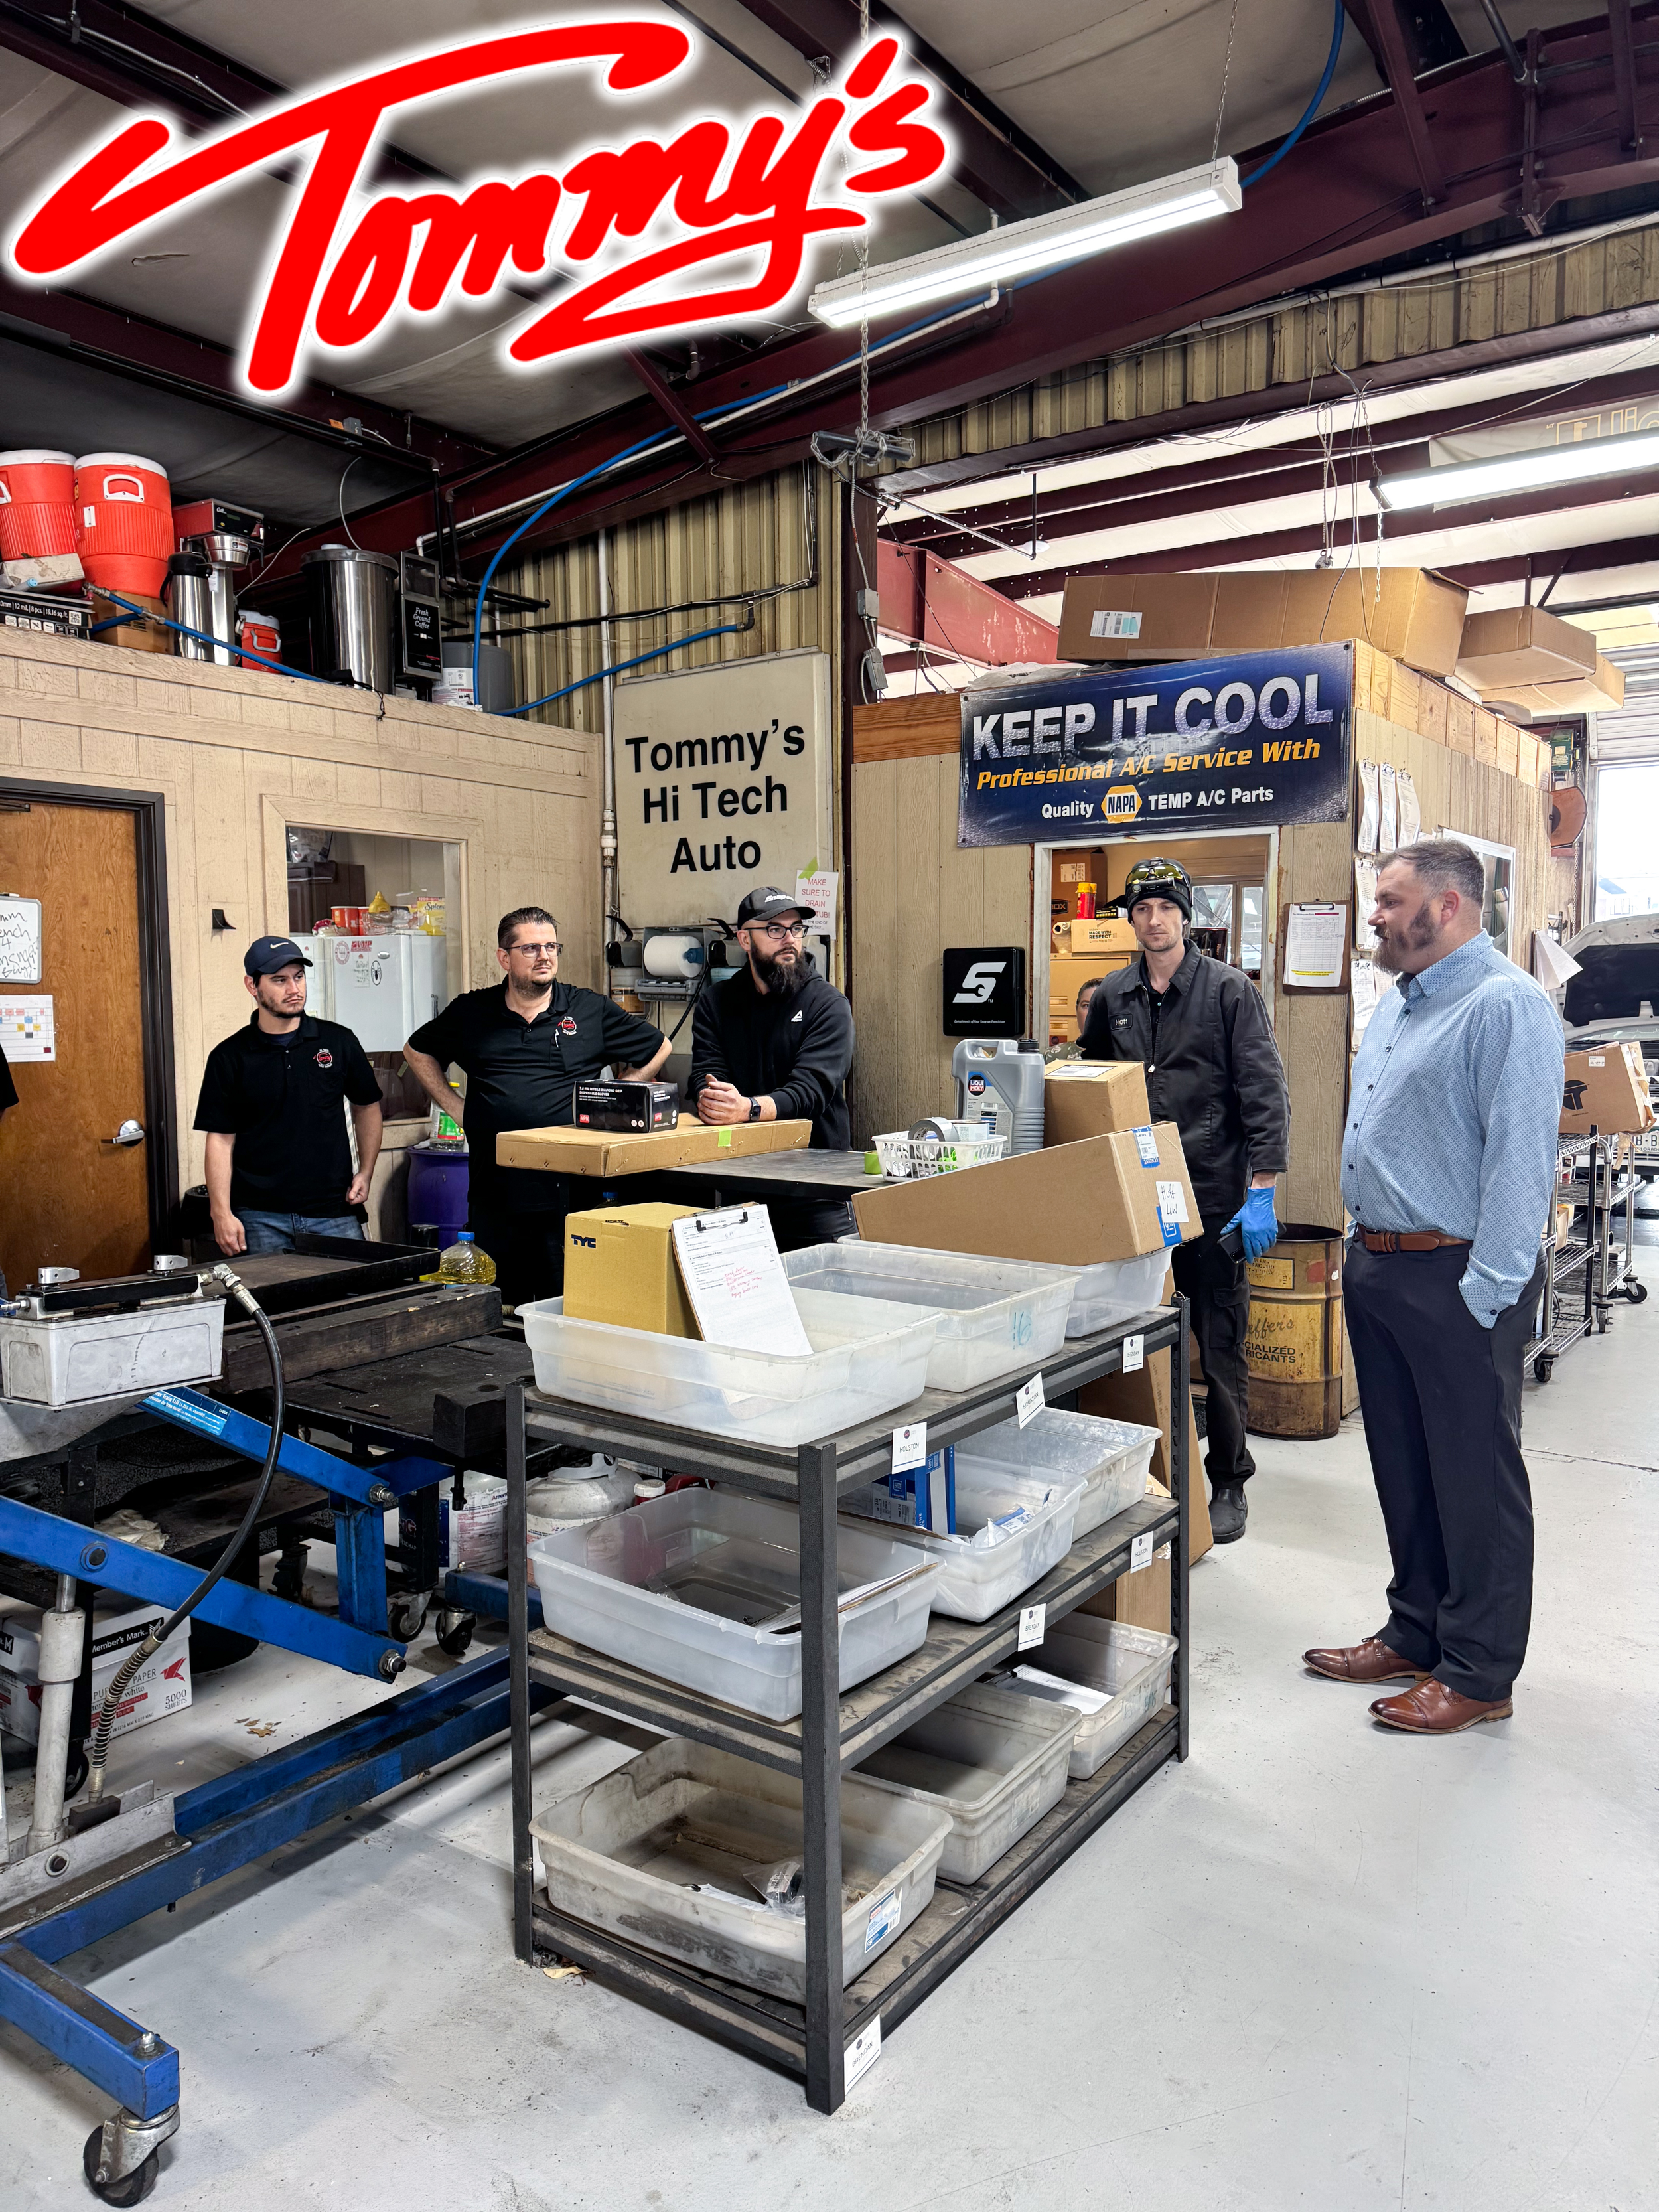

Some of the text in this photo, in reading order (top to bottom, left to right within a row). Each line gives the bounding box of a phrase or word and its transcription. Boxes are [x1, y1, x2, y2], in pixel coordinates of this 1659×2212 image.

[413, 613, 431, 623] Ground
[415, 607, 429, 617] Fresh
[415, 620, 430, 629] Coffee
[972, 673, 1334, 761] KEEP IT COOL
[625, 719, 805, 773] Tommy's
[977, 737, 1320, 790] Professional A/C Service With
[644, 776, 788, 824] Hi Tech
[1041, 786, 1274, 820] Quality NAPA TEMP A/C Parts
[670, 836, 761, 873] Auto
[571, 1234, 596, 1248] TYC
[1243, 1341, 1296, 1355] CIALIZED
[1246, 1349, 1296, 1363] RICANTS
[1023, 1392, 1039, 1410] HOUSTON
[899, 1442, 920, 1453] HOUSTON
[1025, 1623, 1040, 1632] BRENDAN
[126, 1631, 145, 1642] Mark
[133, 1668, 157, 1685] PAPER
[124, 1685, 145, 1698] white
[165, 1689, 187, 1705] 5000
[165, 1698, 188, 1711] SHEETS
[851, 2041, 873, 2067] BRENDAN
